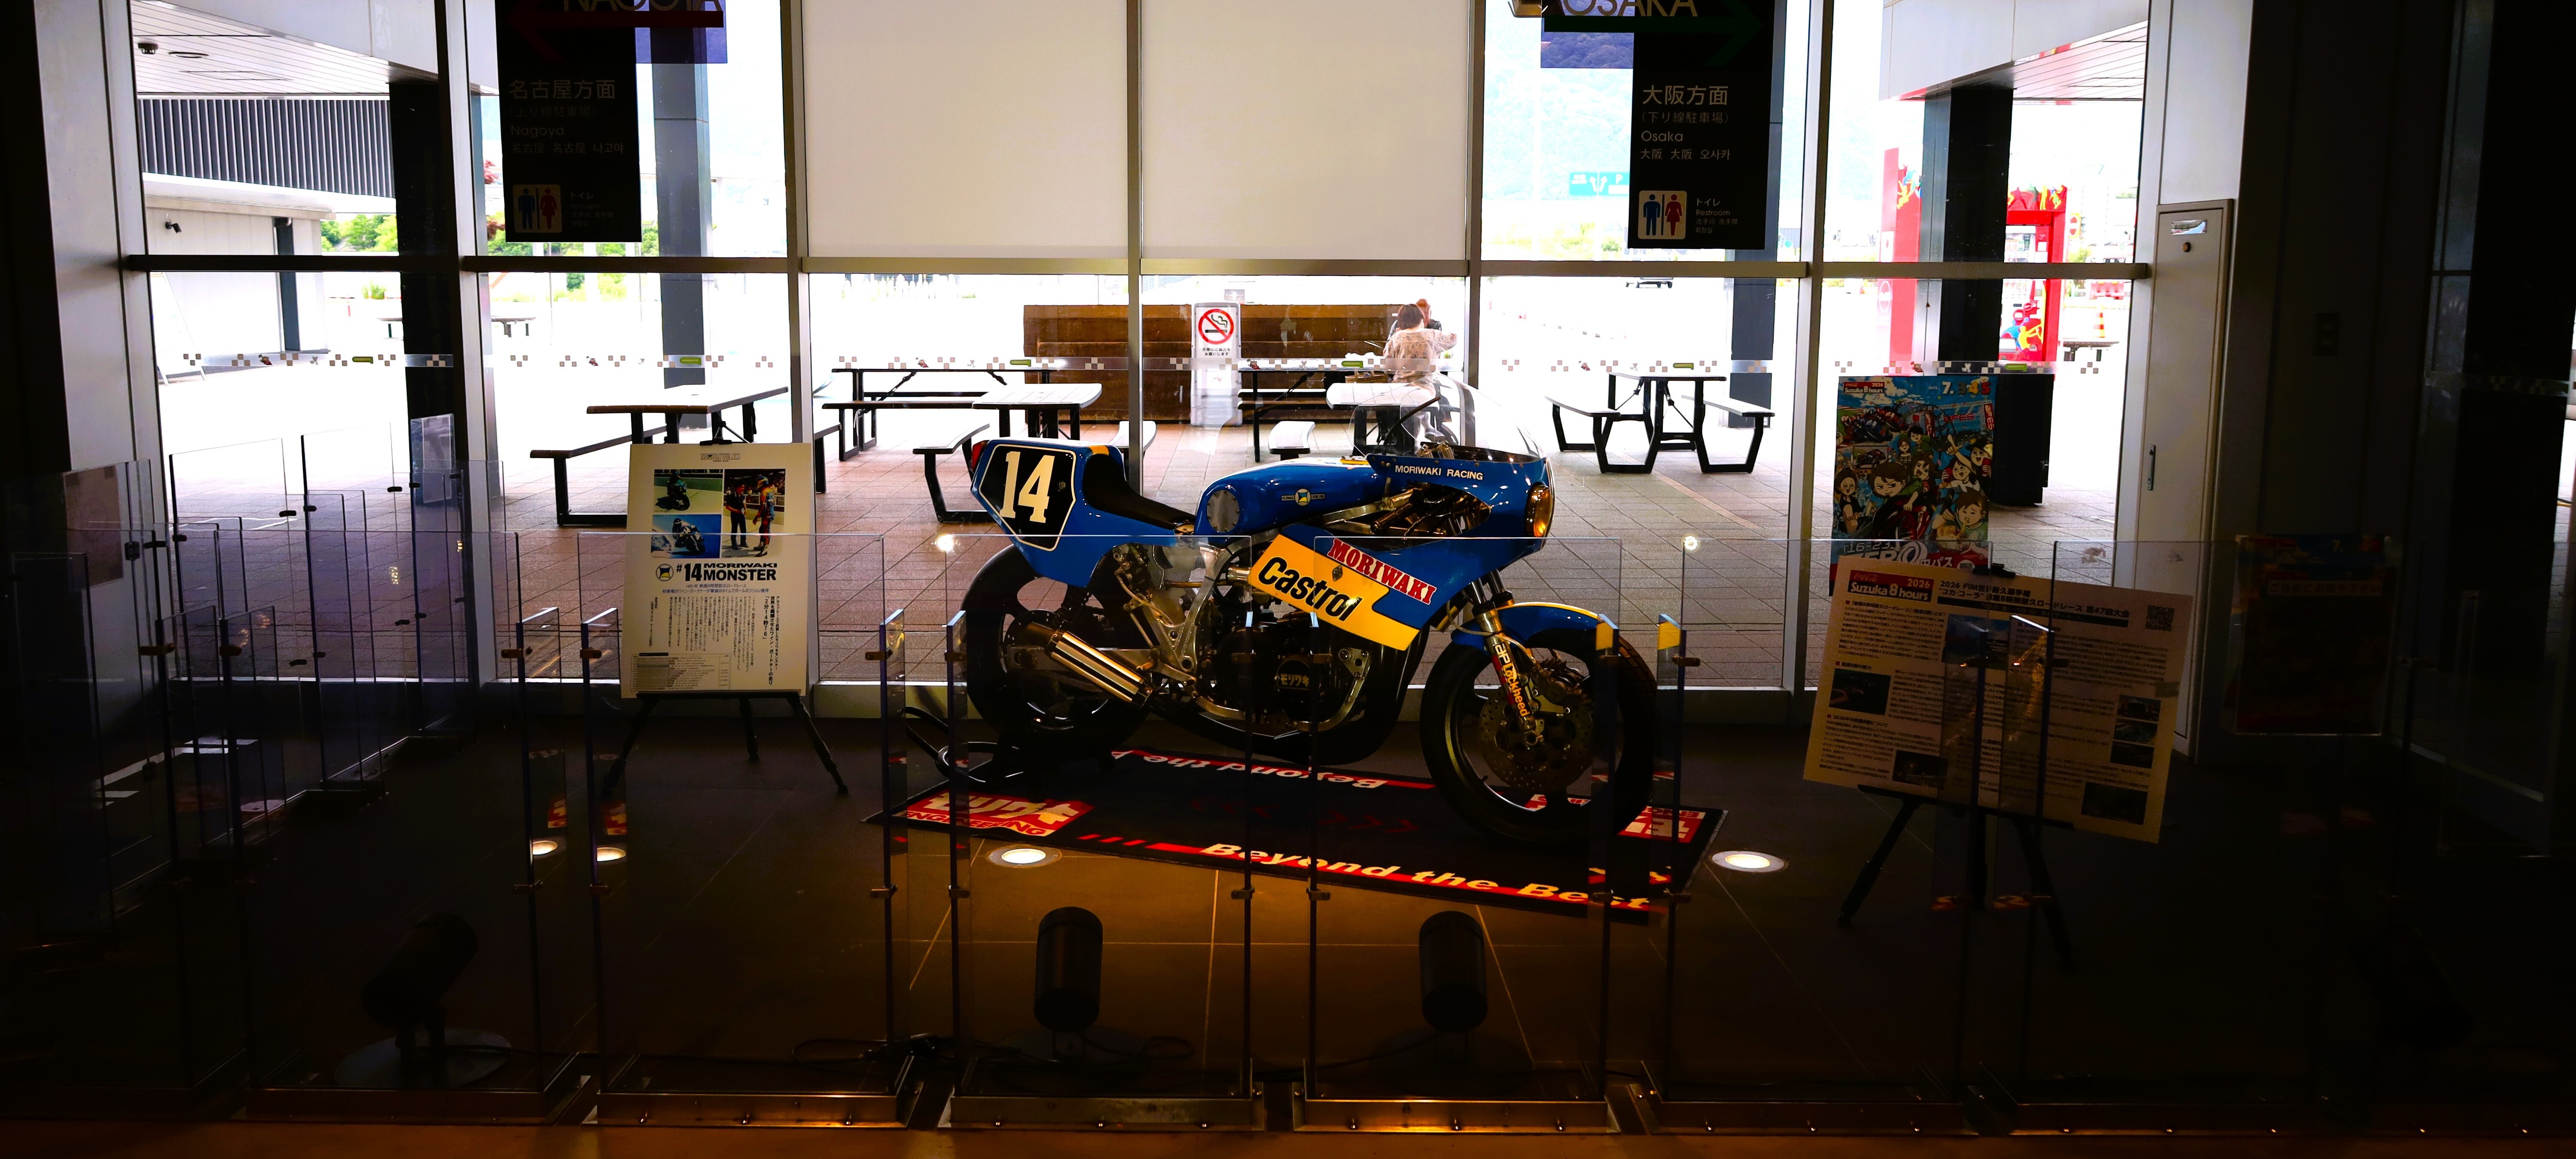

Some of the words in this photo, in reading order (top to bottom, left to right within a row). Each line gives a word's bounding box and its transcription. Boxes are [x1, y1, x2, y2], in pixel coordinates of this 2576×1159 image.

[509, 79, 615, 100] 名古屋方面
[1642, 85, 1729, 106] 大阪方面
[1642, 111, 1729, 124] (下り線駐車場)
[510, 125, 565, 138] Nagoya
[1641, 130, 1683, 142] Osaka
[594, 142, 624, 154] 나고야
[1640, 148, 1662, 160] 大阪
[1670, 148, 1692, 160] 大阪
[1699, 149, 1731, 160] 오사카
[1615, 174, 1623, 184] P
[570, 191, 594, 199] トイレ
[1696, 198, 1720, 206] トイレ
[1968, 382, 1979, 394] 4
[1981, 382, 1991, 395] 5
[1395, 464, 1442, 477] MORIWAKI
[1446, 468, 1483, 481] RACING
[1000, 451, 1055, 523] 14
[703, 569, 777, 581] MONSTER
[1327, 538, 1437, 605] MORIWAKI
[1257, 557, 1363, 622] Castrol
[1907, 578, 1930, 589] 2026
[1940, 580, 1961, 589] 2026
[1850, 582, 1887, 595] Suzuka
[1889, 583, 1898, 596] 8
[1898, 588, 1928, 601] hours
[1280, 673, 1310, 687] モリワキ
[1503, 662, 1531, 717] Lockheed
[1199, 843, 1401, 878] Beyond
[1411, 870, 1499, 890] the
